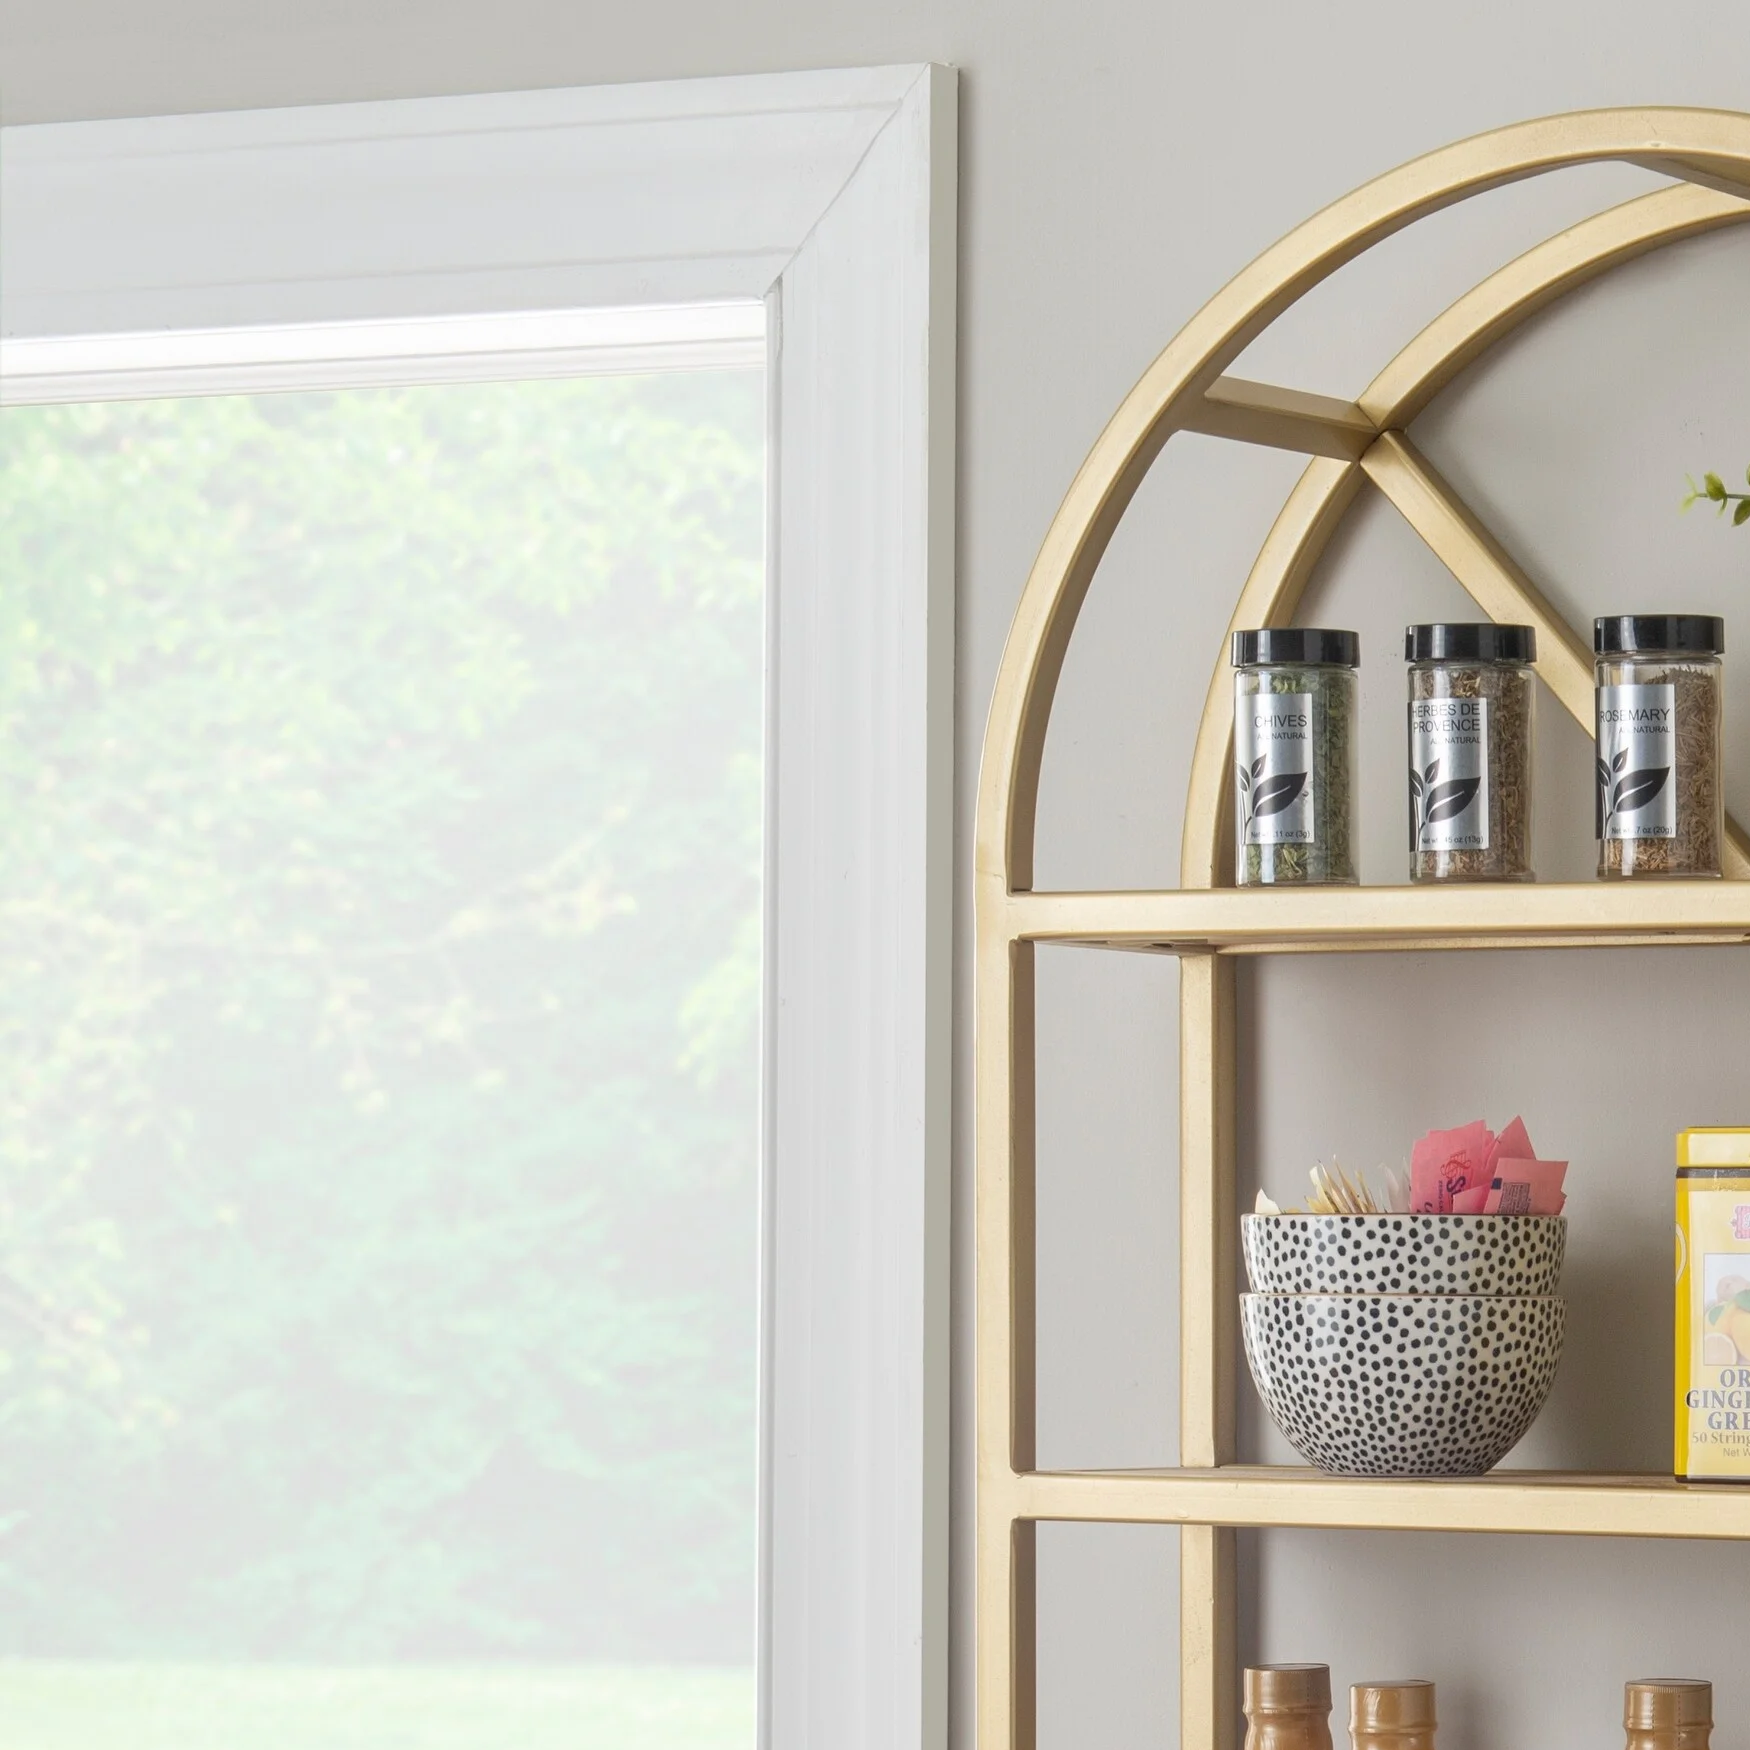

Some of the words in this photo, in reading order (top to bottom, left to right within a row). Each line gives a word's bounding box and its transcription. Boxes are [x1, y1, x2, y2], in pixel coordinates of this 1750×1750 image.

[1412, 703, 1457, 717] HERBES
[1460, 703, 1480, 716] DE
[1600, 708, 1670, 723] ROSEMARY
[1254, 714, 1308, 728] CHIVES
[1413, 718, 1480, 733] PROVENCE
[1633, 725, 1670, 734] NATURAL
[1271, 731, 1308, 740] NATURAL
[1445, 737, 1481, 746] NATURAL
[1295, 829, 1310, 839] (3g)
[1653, 825, 1672, 835] (20g)
[1453, 836, 1463, 844] oz
[1692, 1431, 1708, 1443] 50
[1723, 1447, 1740, 1457] Net
